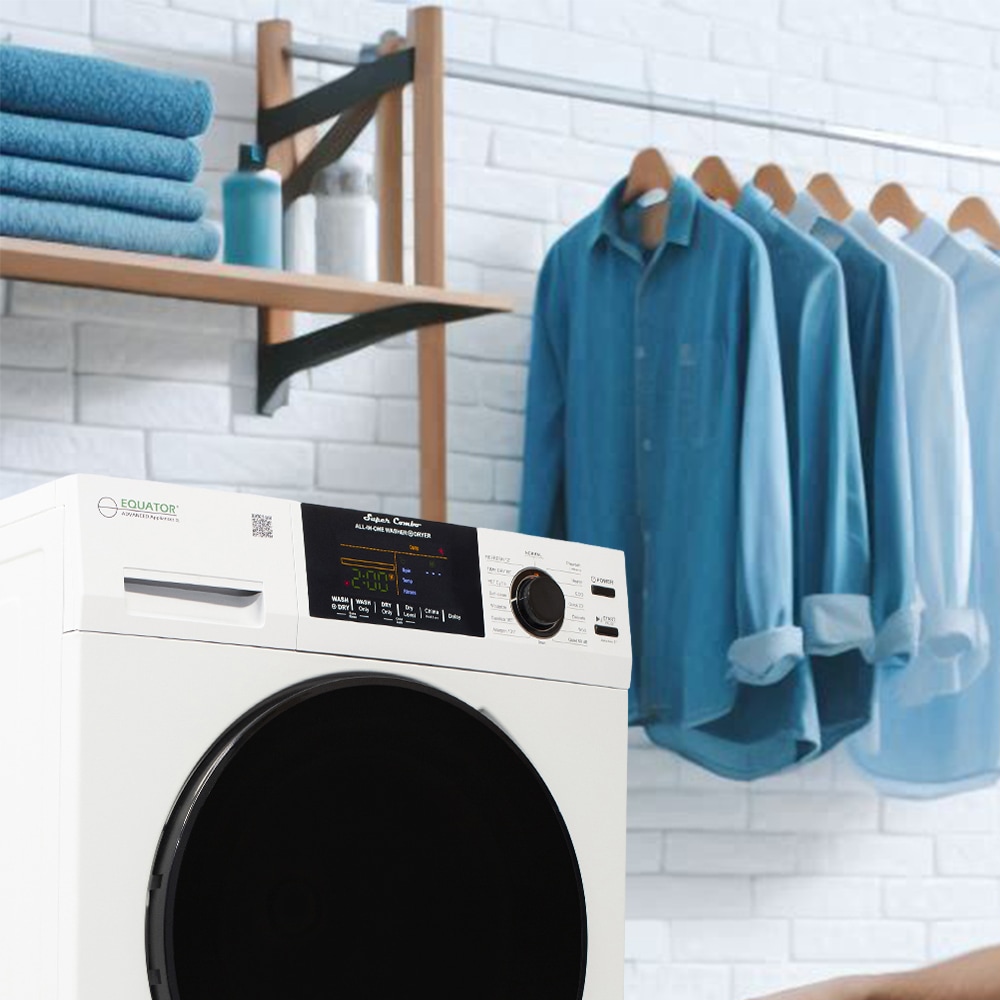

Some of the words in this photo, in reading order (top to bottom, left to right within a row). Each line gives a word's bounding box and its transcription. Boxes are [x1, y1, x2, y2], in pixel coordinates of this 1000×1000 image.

[121, 498, 176, 514] EQUATOR
[363, 513, 391, 524] Super
[392, 516, 422, 528] Combo
[351, 567, 389, 593] 2:00
[331, 595, 349, 603] WASH
[355, 598, 371, 606] WASH
